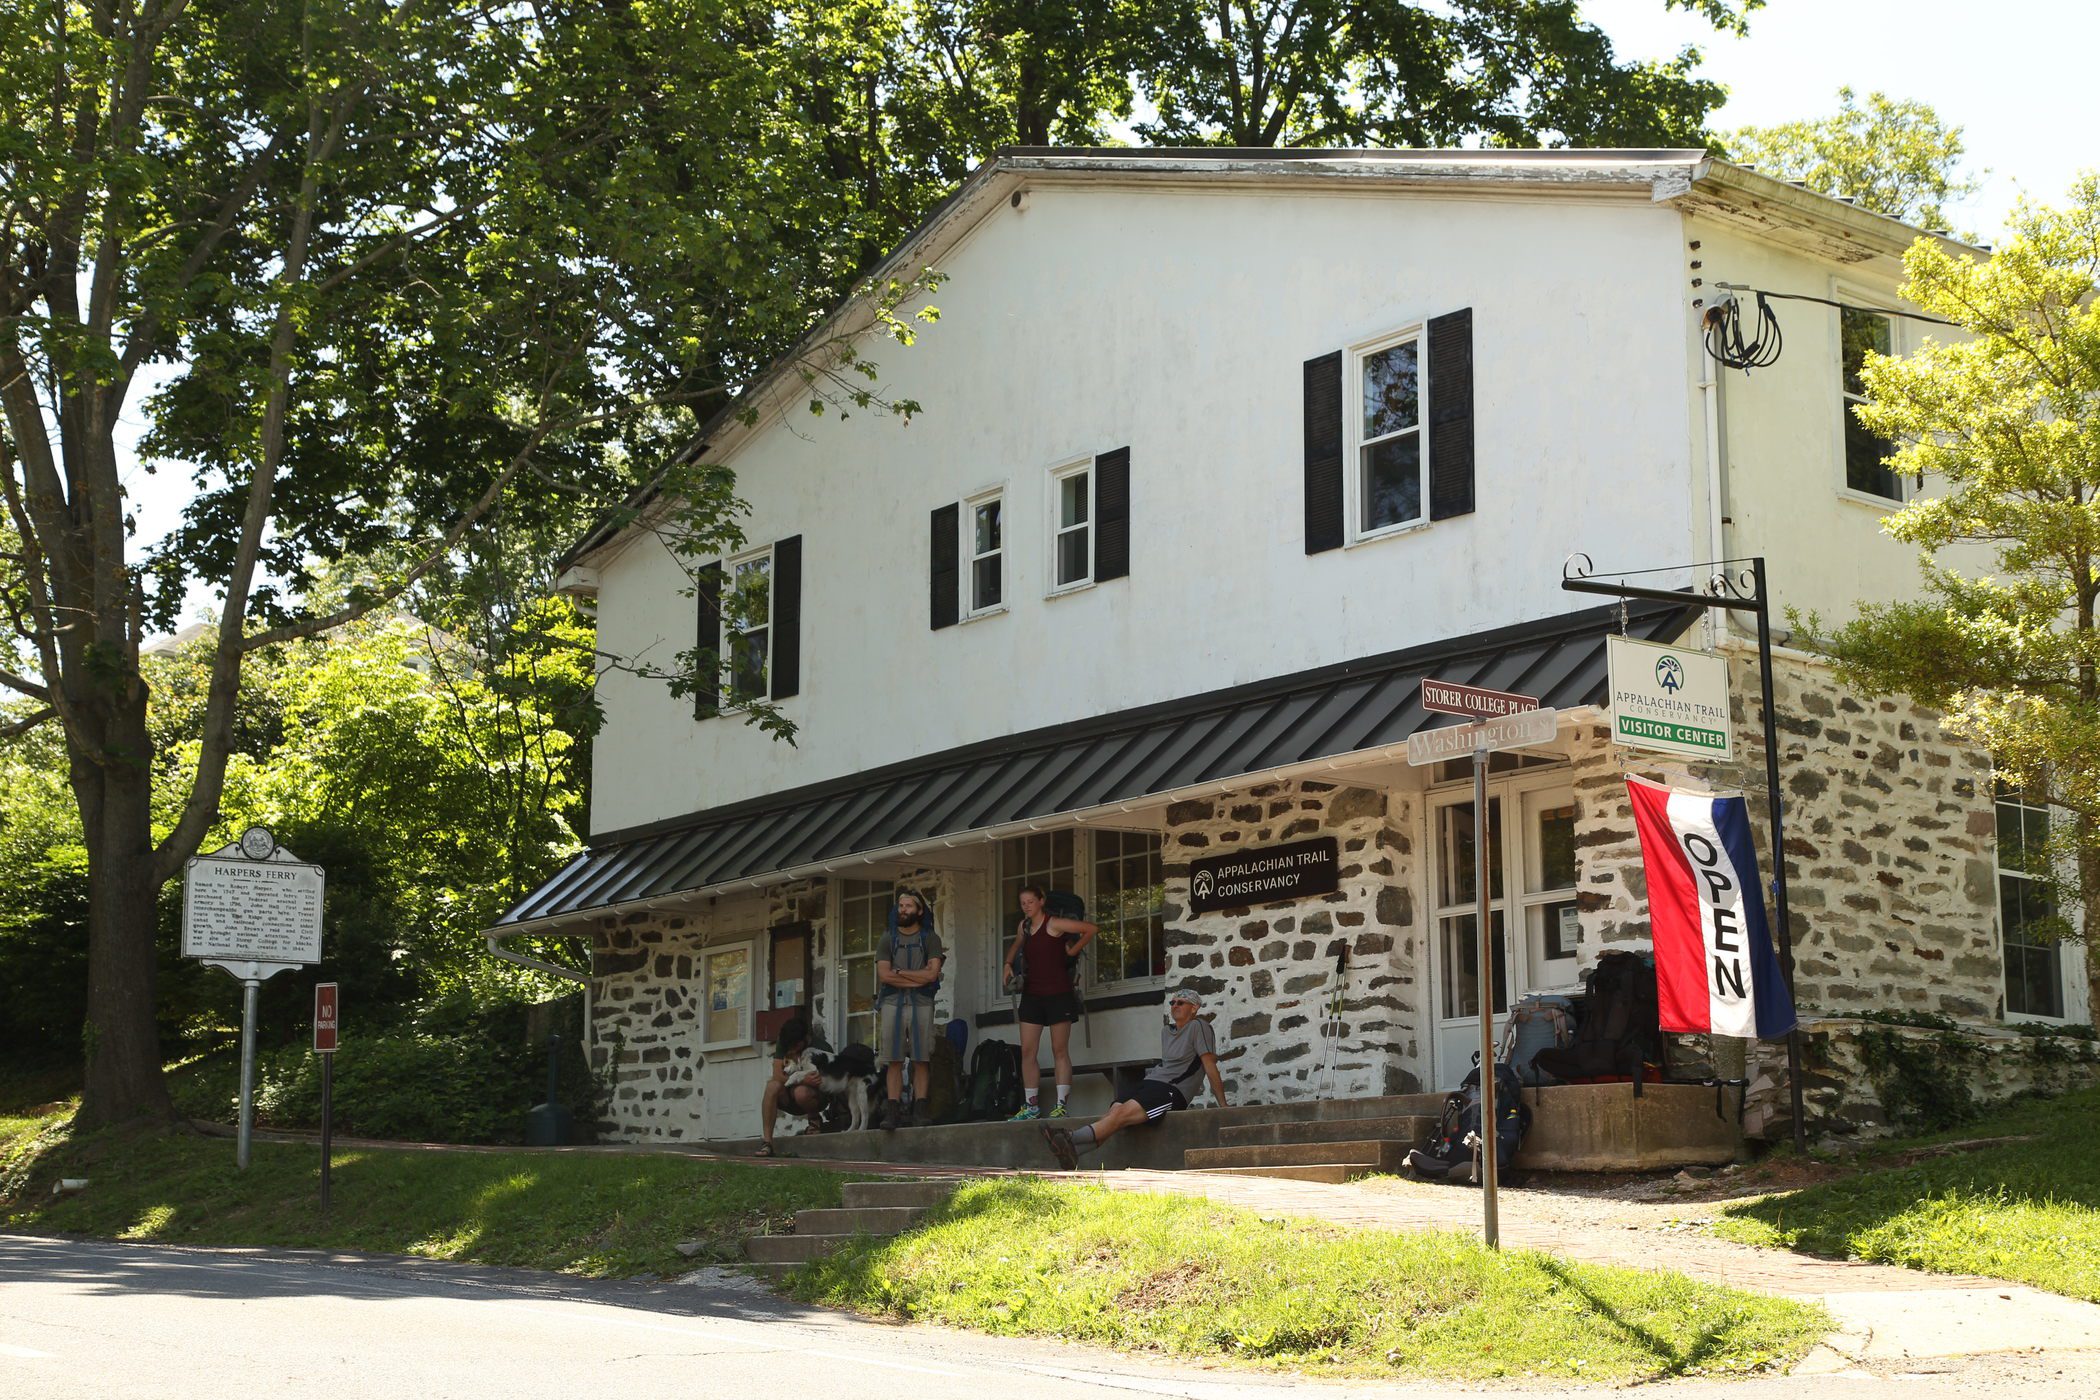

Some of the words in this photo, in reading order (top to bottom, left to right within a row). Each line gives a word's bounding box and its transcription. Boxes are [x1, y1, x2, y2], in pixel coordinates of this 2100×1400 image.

[1425, 687, 1462, 707] STORER
[1465, 693, 1506, 714] COLLEGE
[1616, 691, 1691, 712] APPALACHIAN
[1694, 704, 1725, 719] TRAIL
[1630, 705, 1713, 725] CONSERVANCY
[1411, 721, 1530, 757] Washington
[1621, 719, 1672, 738] VISITOR
[1676, 728, 1724, 747] CENTER
[215, 867, 262, 878] HARPERS
[266, 871, 297, 880] FERRY
[1217, 855, 1294, 879] APPALACHIAN
[1297, 849, 1330, 866] TRAIL
[1218, 873, 1301, 898] CONSERVANCY
[1684, 833, 1747, 999] OPEN
[322, 1004, 332, 1018] NO
[318, 1020, 336, 1030] PARKING
